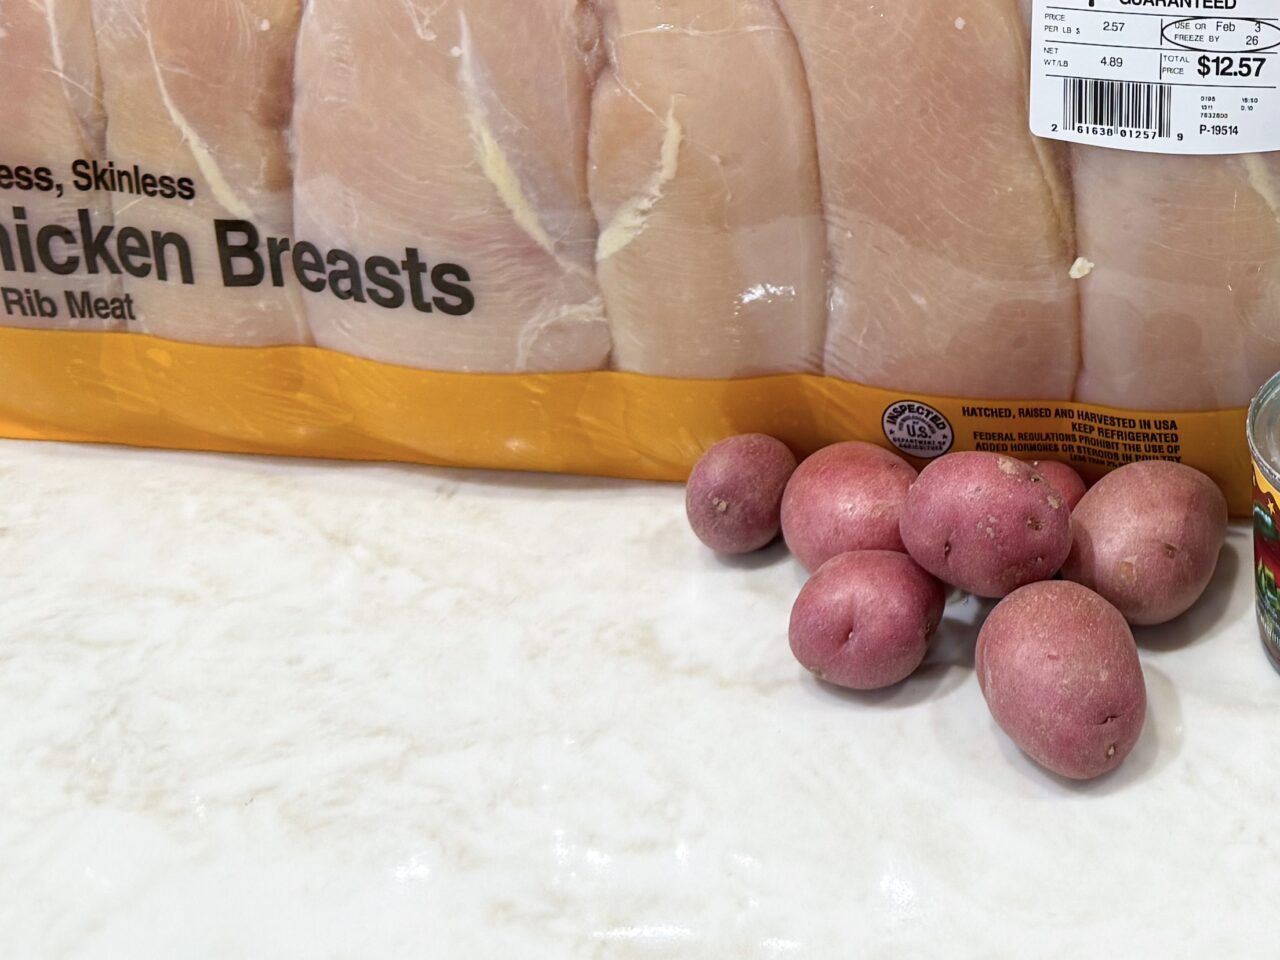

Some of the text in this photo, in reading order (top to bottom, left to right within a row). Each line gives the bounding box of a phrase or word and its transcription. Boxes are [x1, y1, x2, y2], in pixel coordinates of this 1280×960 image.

[1063, 26, 1072, 34] LB
[1102, 21, 1125, 32] 2.57
[1174, 22, 1190, 30] USE
[1215, 20, 1236, 32] Feb
[1254, 22, 1261, 33] 3
[1174, 33, 1259, 46] FREEZE BY 26
[1043, 46, 1059, 54] NET
[1163, 54, 1190, 63] TOTAL
[1100, 56, 1123, 68] 4.89
[1197, 54, 1266, 78] $12.57
[1051, 123, 1184, 141] 2 61638 01257 9
[1199, 124, 1239, 136] P-19514
[71, 158, 196, 200] Skinless
[213, 218, 475, 316] Breasts
[0, 287, 137, 321] Rib Meat
[886, 404, 947, 430] INSPECTED
[962, 406, 1178, 431] HATCHED, RAISED AND HARVESTED IN USA
[906, 423, 932, 439] U.S.
[1071, 422, 1179, 443] KEEP REFRIGERATED
[973, 431, 1180, 454] FEDERAL REGULATIONS PROHIBIT THE USE OF
[975, 442, 1008, 452] ADDED
[1010, 442, 1059, 452] HORMONES
[1062, 444, 1075, 453] OR
